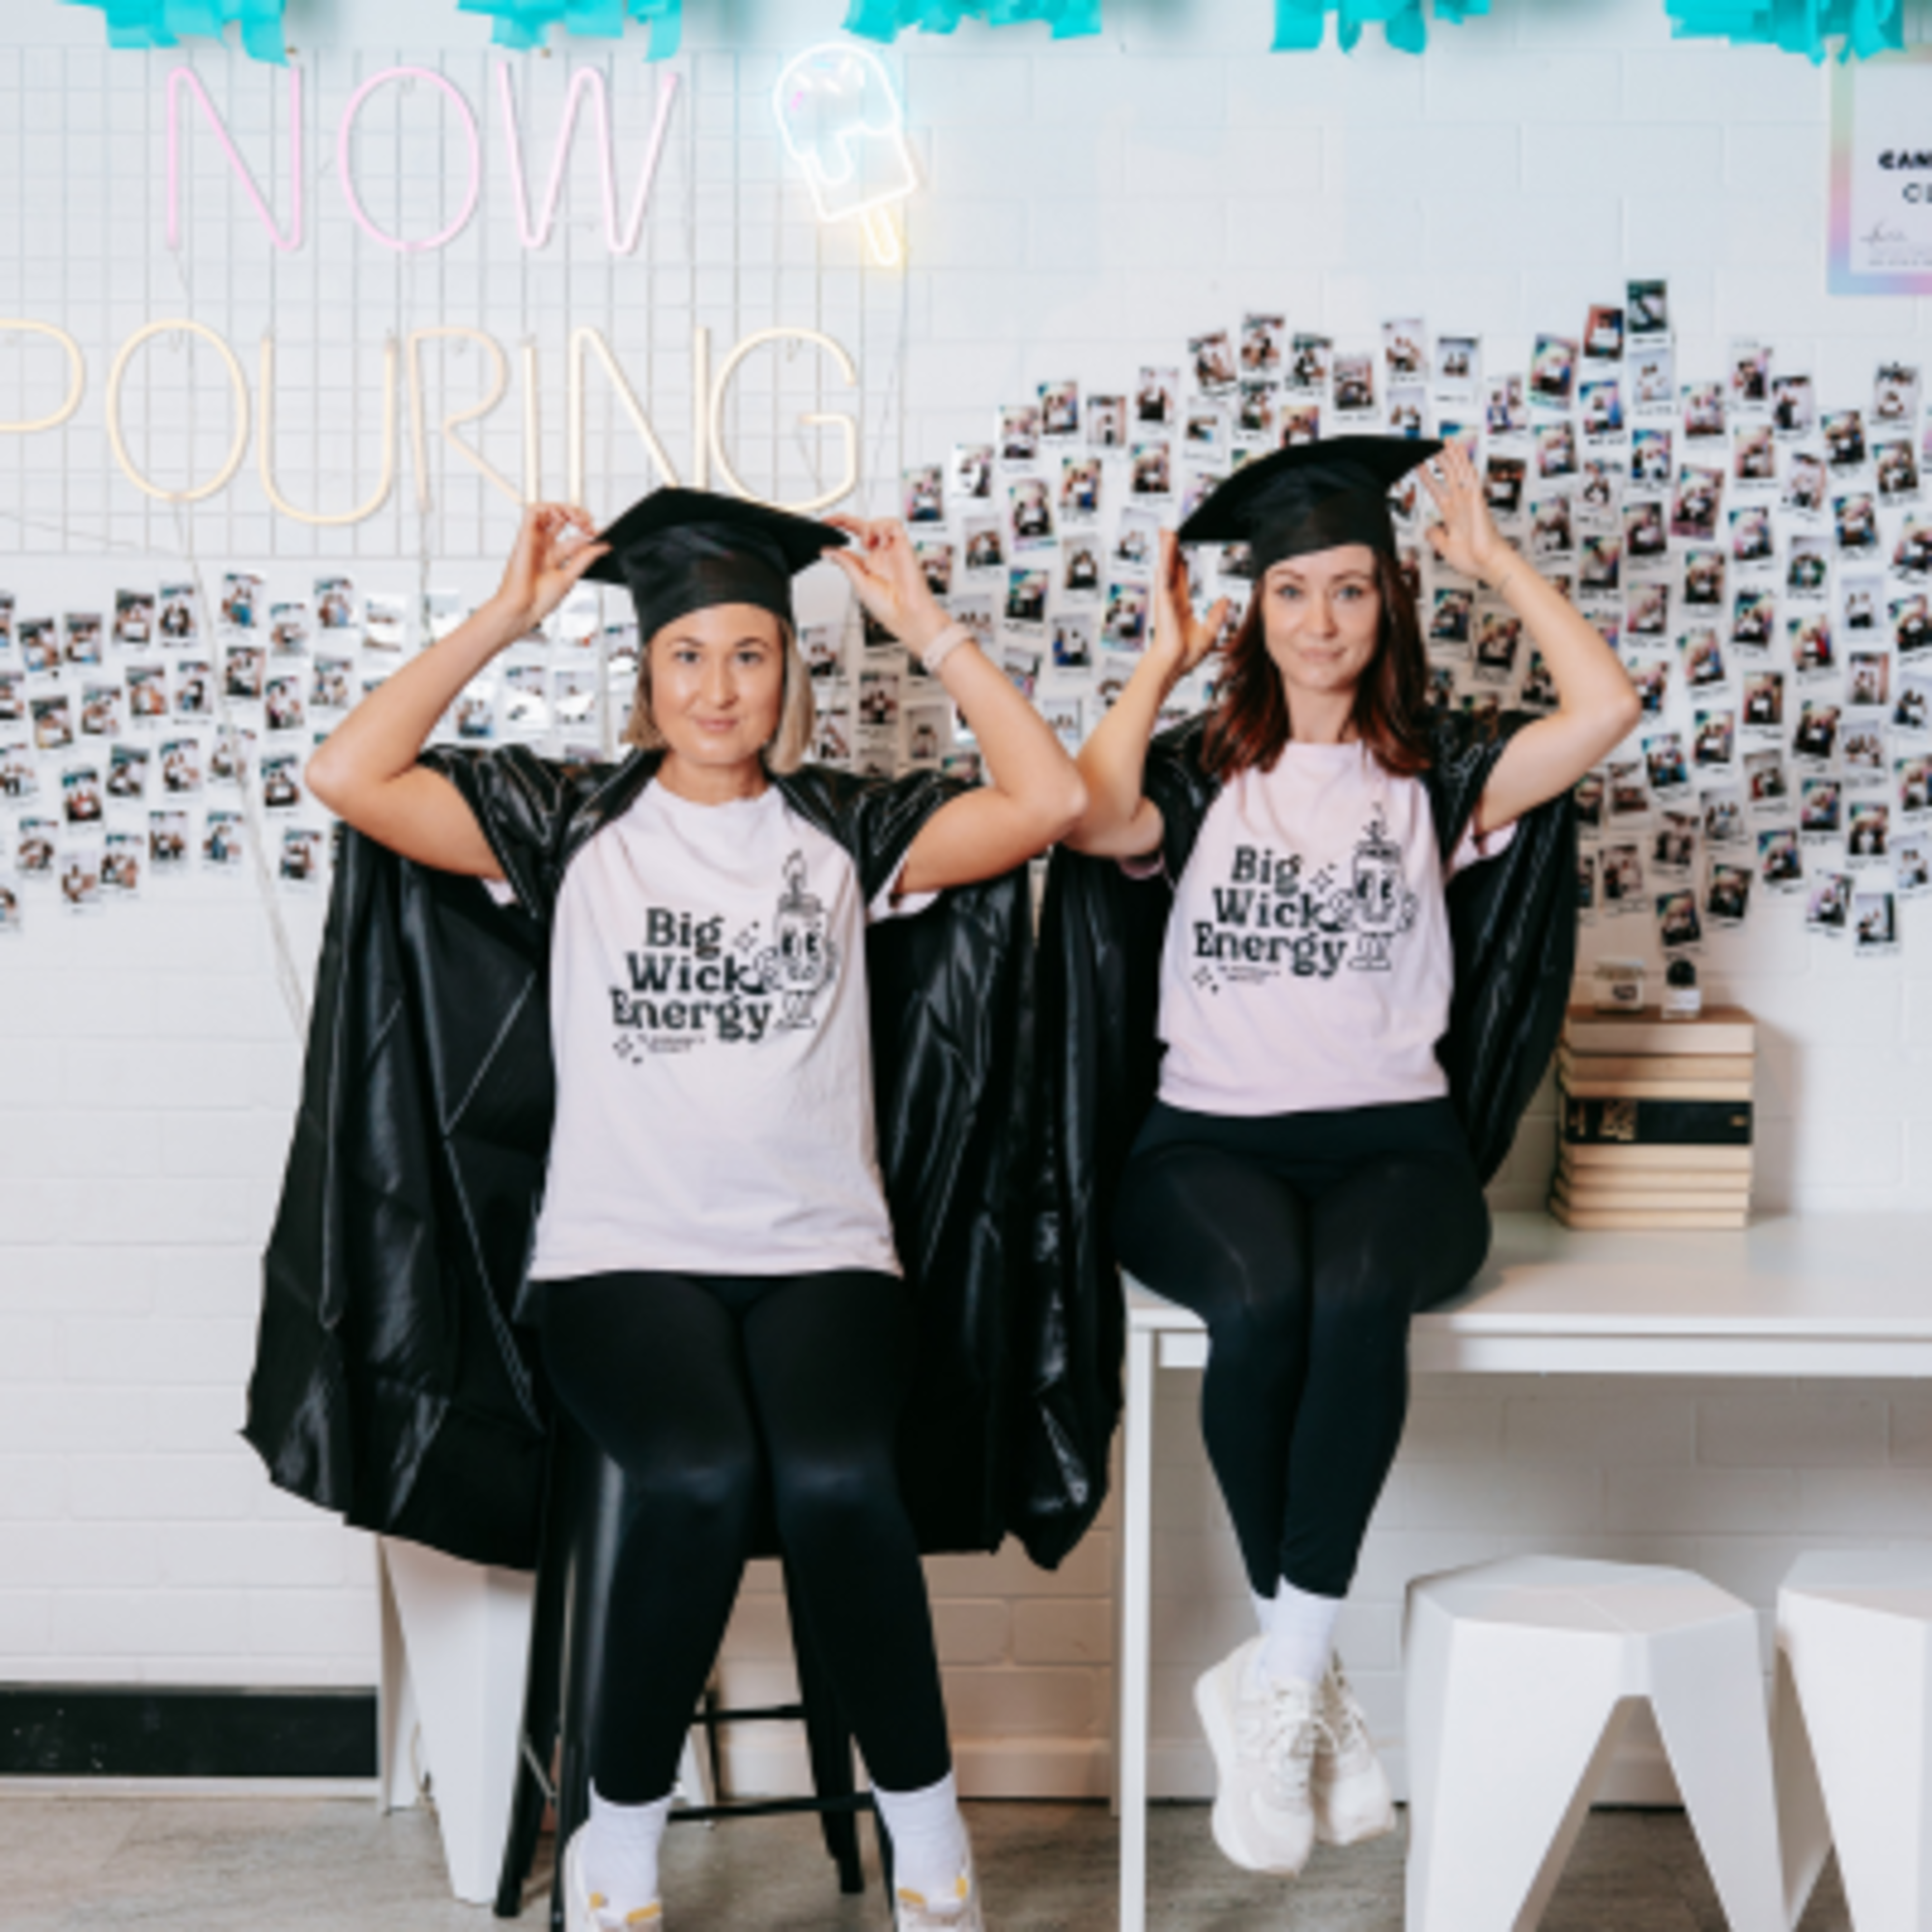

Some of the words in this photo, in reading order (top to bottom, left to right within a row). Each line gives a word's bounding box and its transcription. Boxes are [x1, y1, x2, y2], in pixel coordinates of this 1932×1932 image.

[167, 62, 677, 254] NOW
[0, 318, 860, 525] POURING
[1231, 843, 1301, 897] Big
[645, 906, 725, 961] Big
[1212, 887, 1345, 933] Wick
[626, 951, 770, 995] Wick
[1193, 921, 1348, 979] Energy
[609, 984, 773, 1043] Energy
